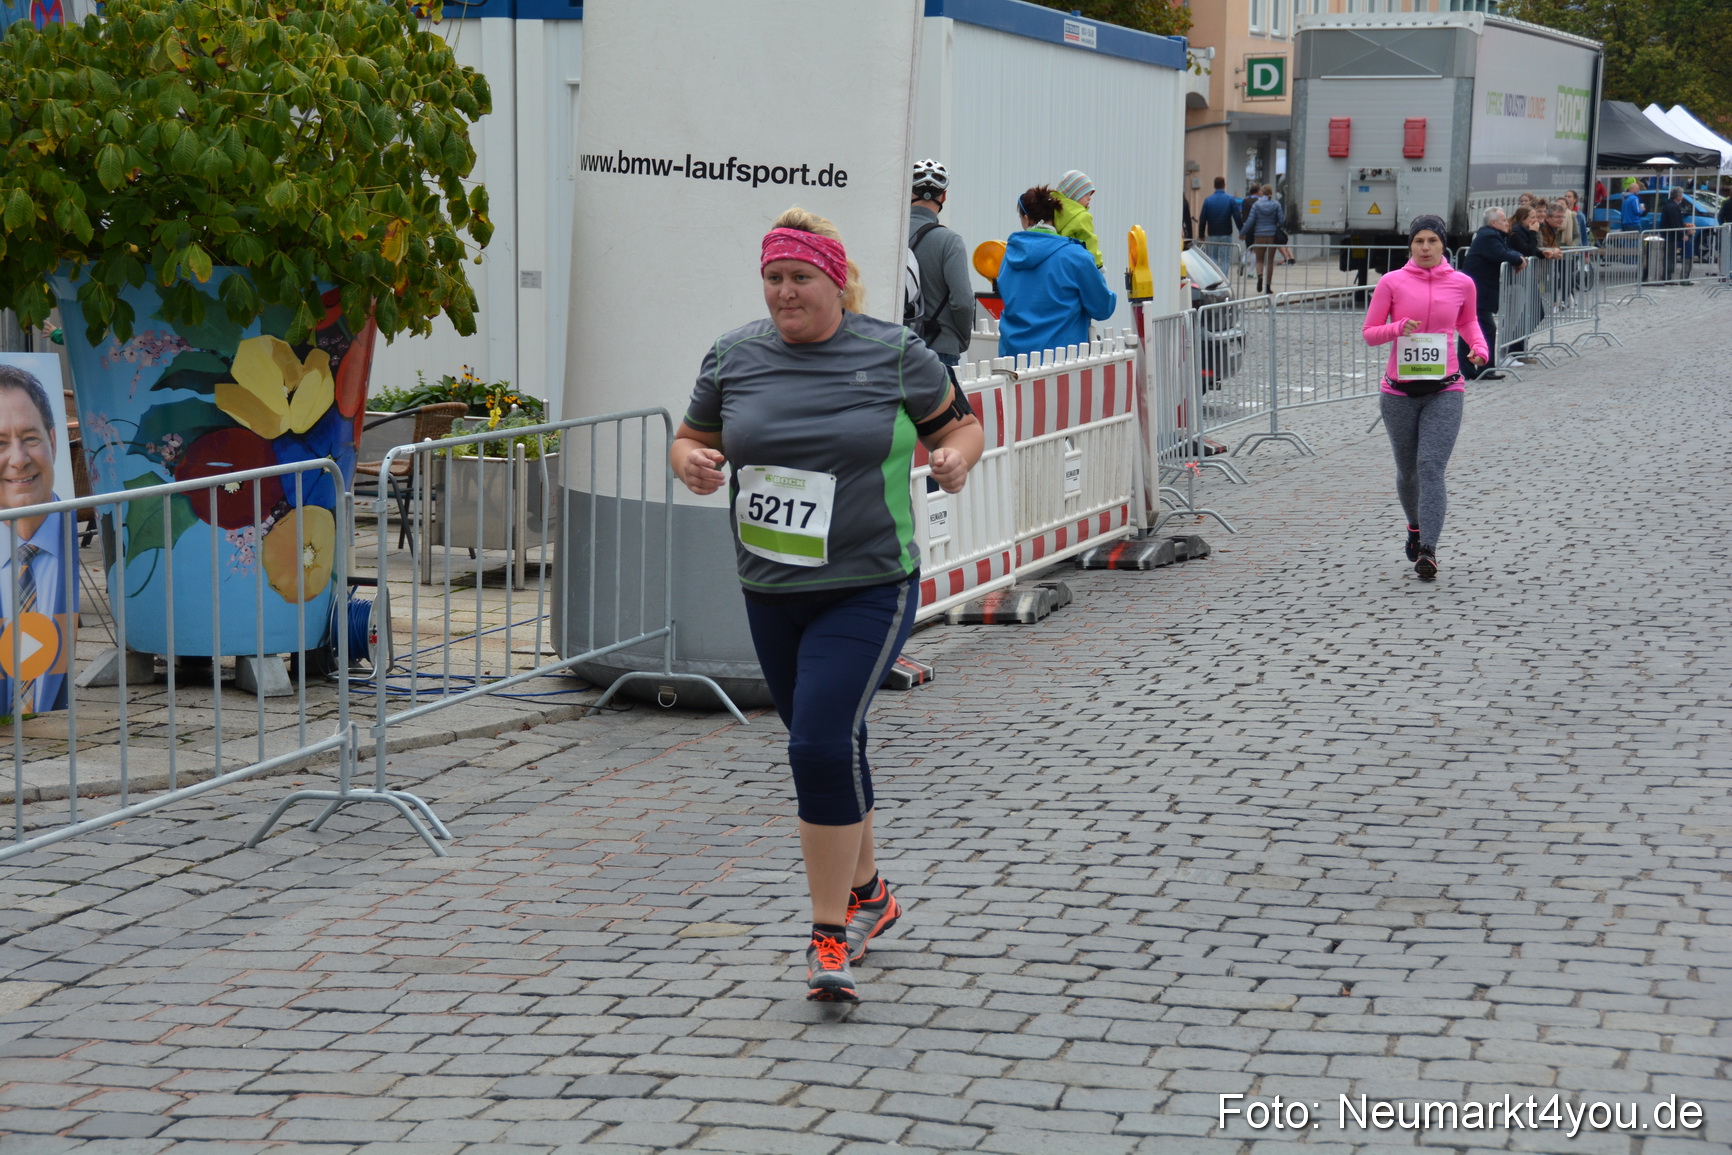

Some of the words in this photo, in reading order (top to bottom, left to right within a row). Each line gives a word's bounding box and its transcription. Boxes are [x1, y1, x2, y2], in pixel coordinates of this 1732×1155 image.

[1253, 63, 1279, 91] D
[1555, 87, 1589, 138] BOCK
[580, 150, 848, 188] www.bmw-laufsport.de
[1403, 347, 1440, 362] 5159
[773, 474, 806, 487] BOCK
[748, 492, 817, 529] 5217
